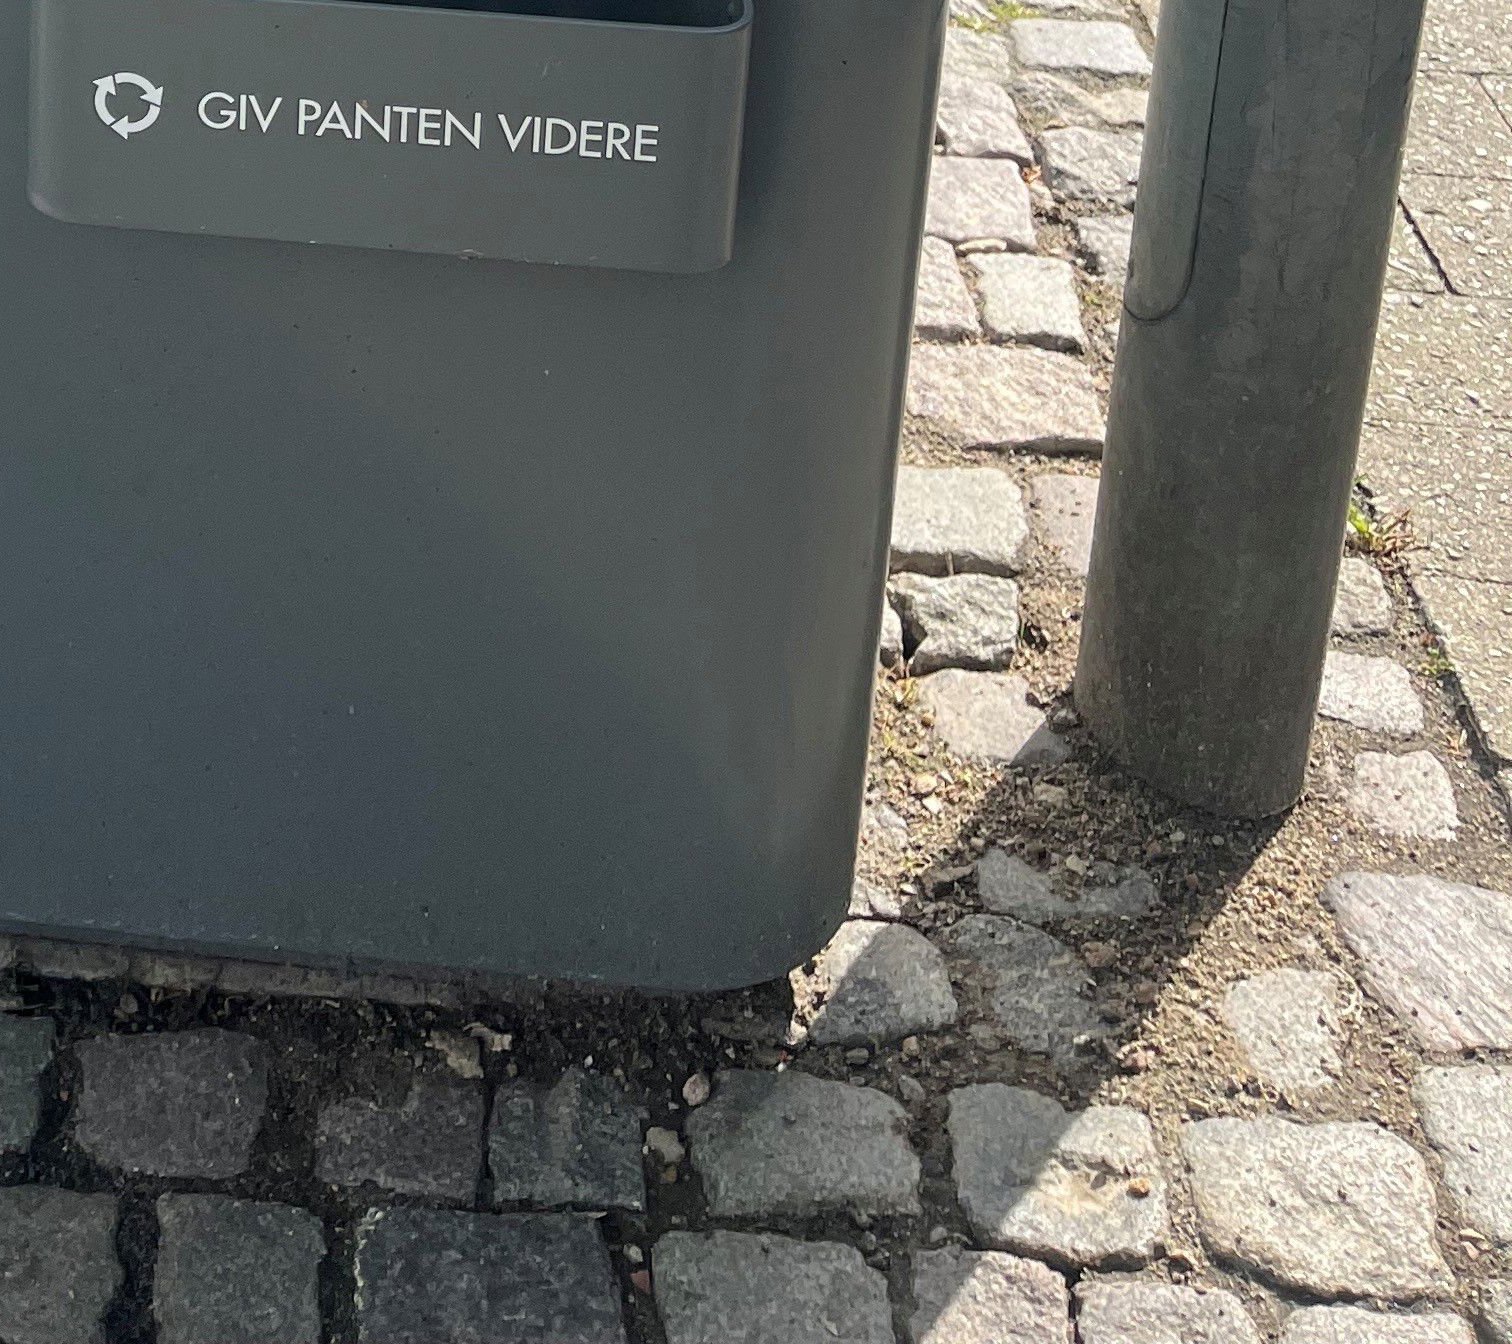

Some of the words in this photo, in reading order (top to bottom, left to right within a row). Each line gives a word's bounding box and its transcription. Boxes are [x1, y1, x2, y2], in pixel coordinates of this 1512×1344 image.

[197, 91, 283, 134] GIV
[297, 98, 482, 150] PANTEN
[497, 113, 660, 162] VIDERE
